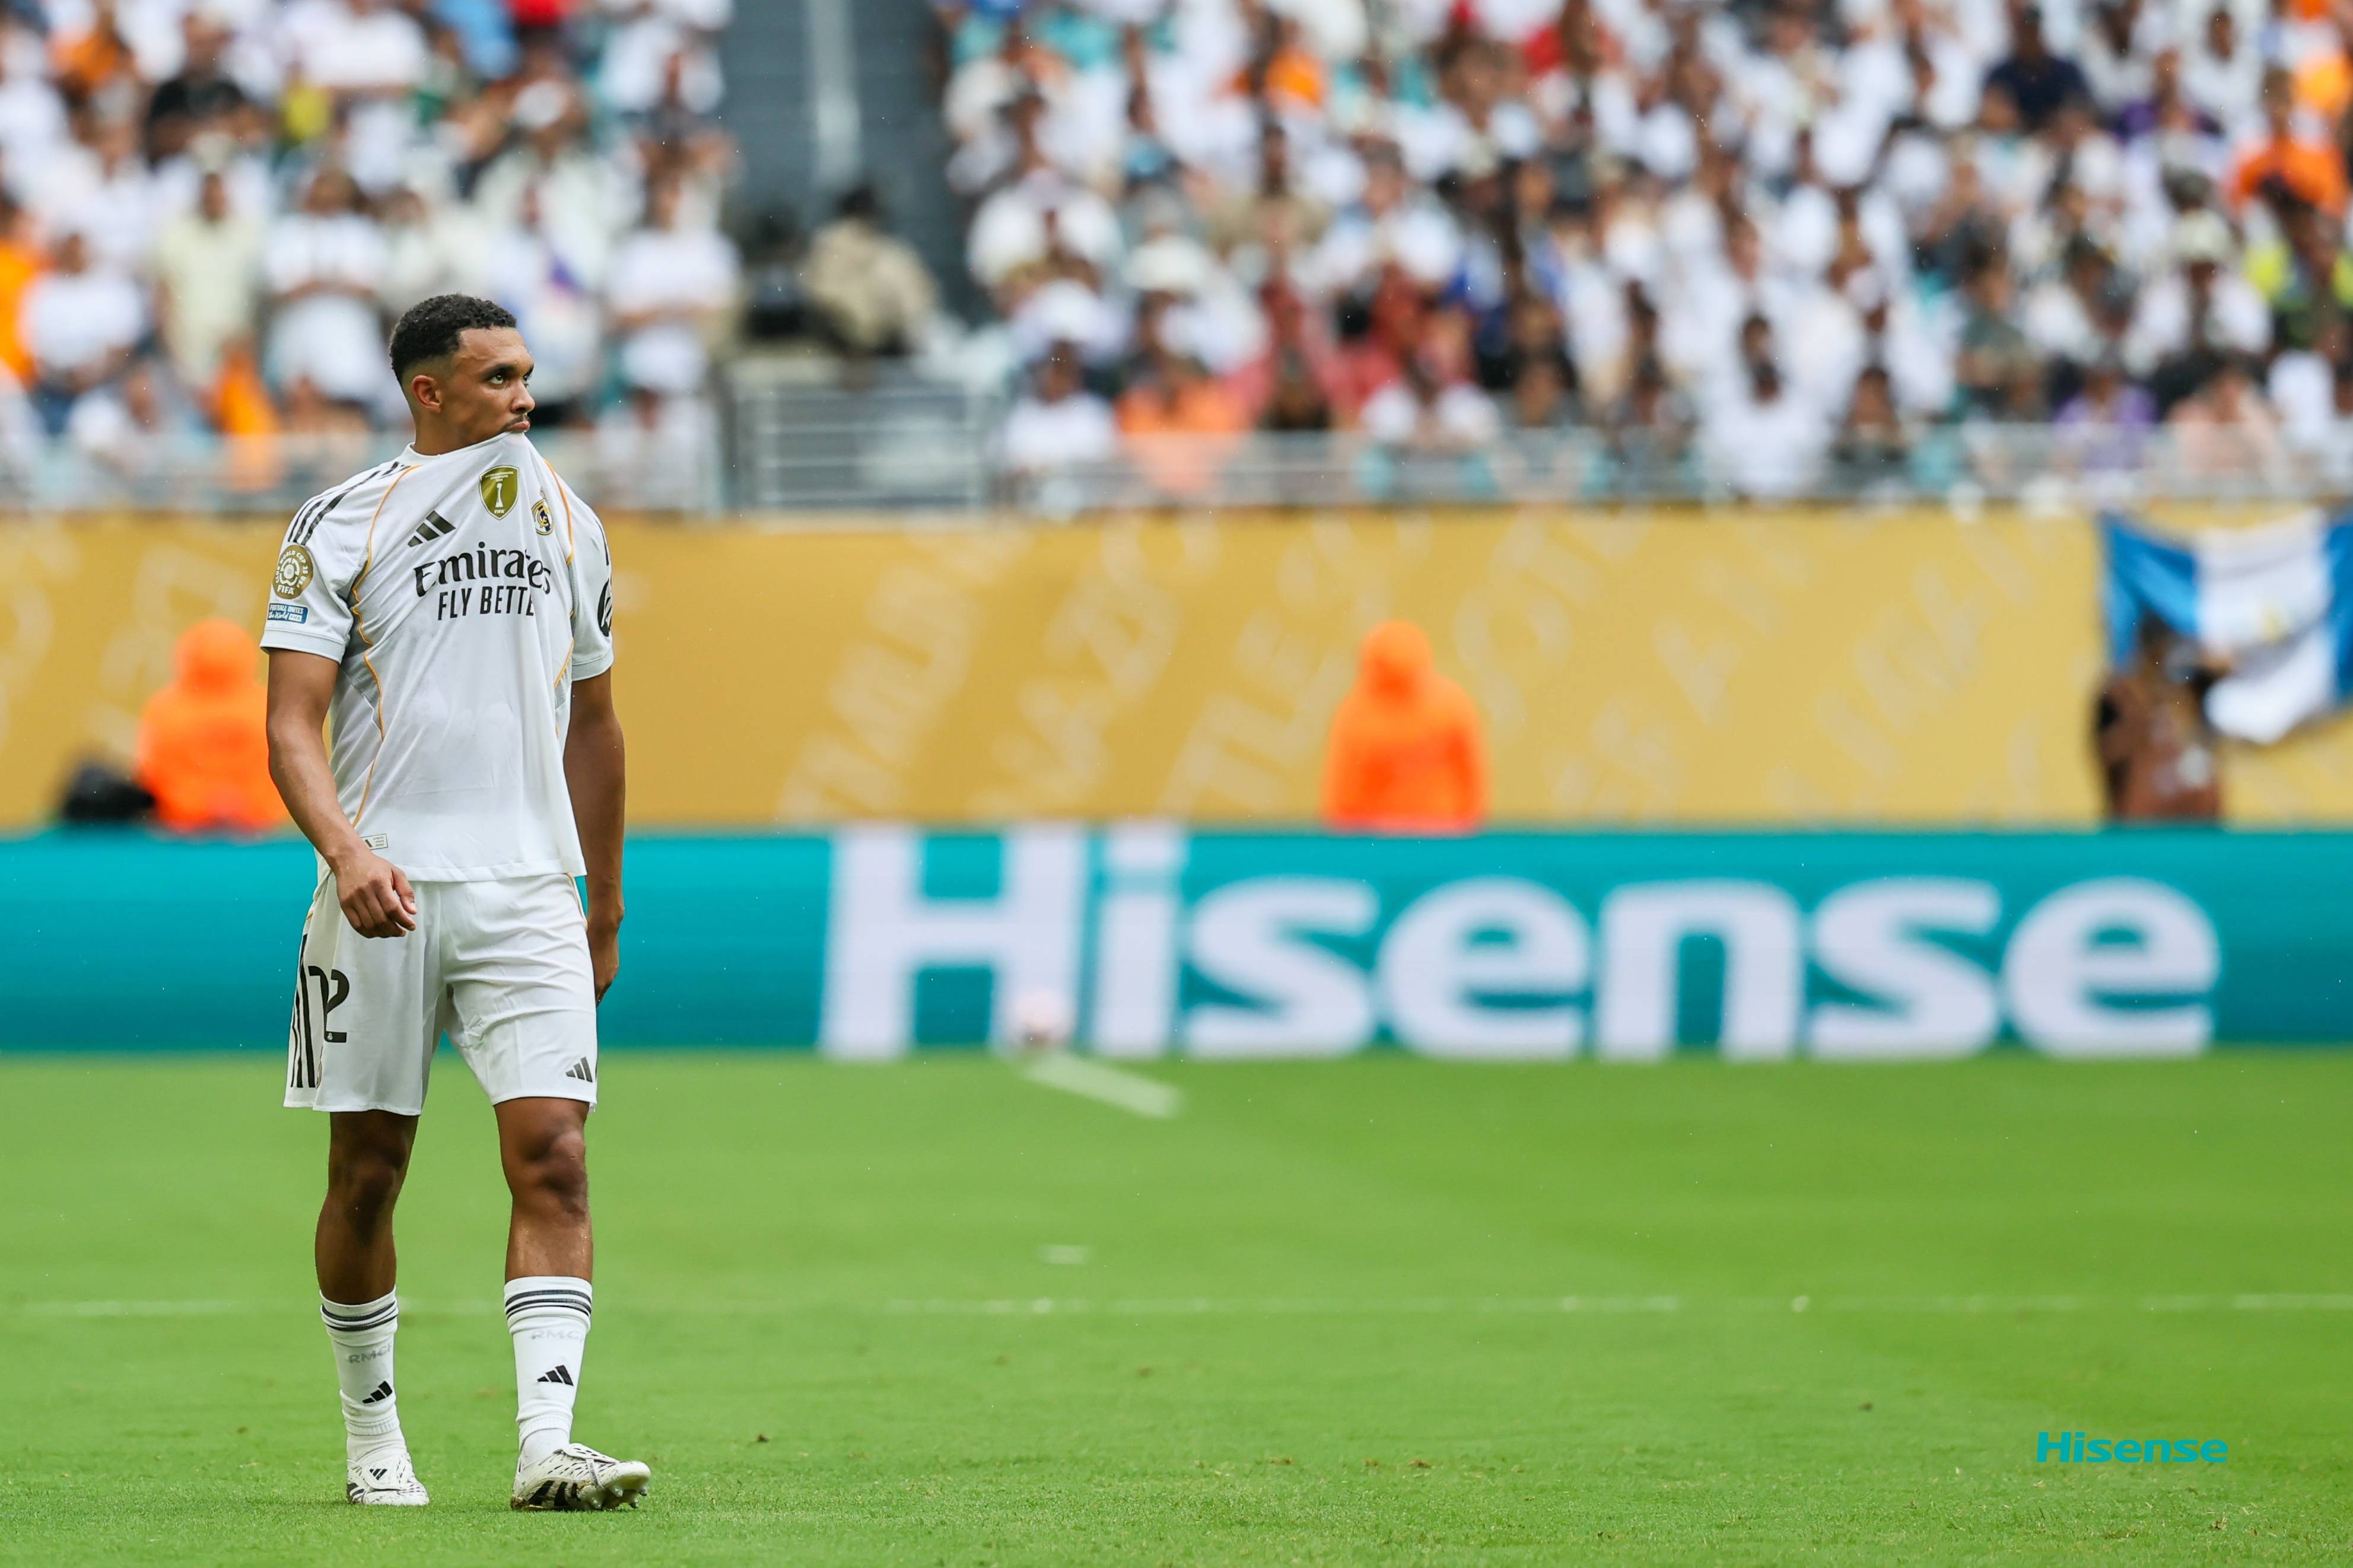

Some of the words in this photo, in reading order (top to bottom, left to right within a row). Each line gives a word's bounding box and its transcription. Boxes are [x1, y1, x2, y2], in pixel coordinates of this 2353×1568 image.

[279, 550, 295, 564] WORLD
[296, 552, 307, 564] CUP
[277, 584, 295, 595] FIFA
[438, 587, 472, 621] FLY
[480, 586, 534, 616] BETTE
[819, 828, 2221, 1060] Hisense
